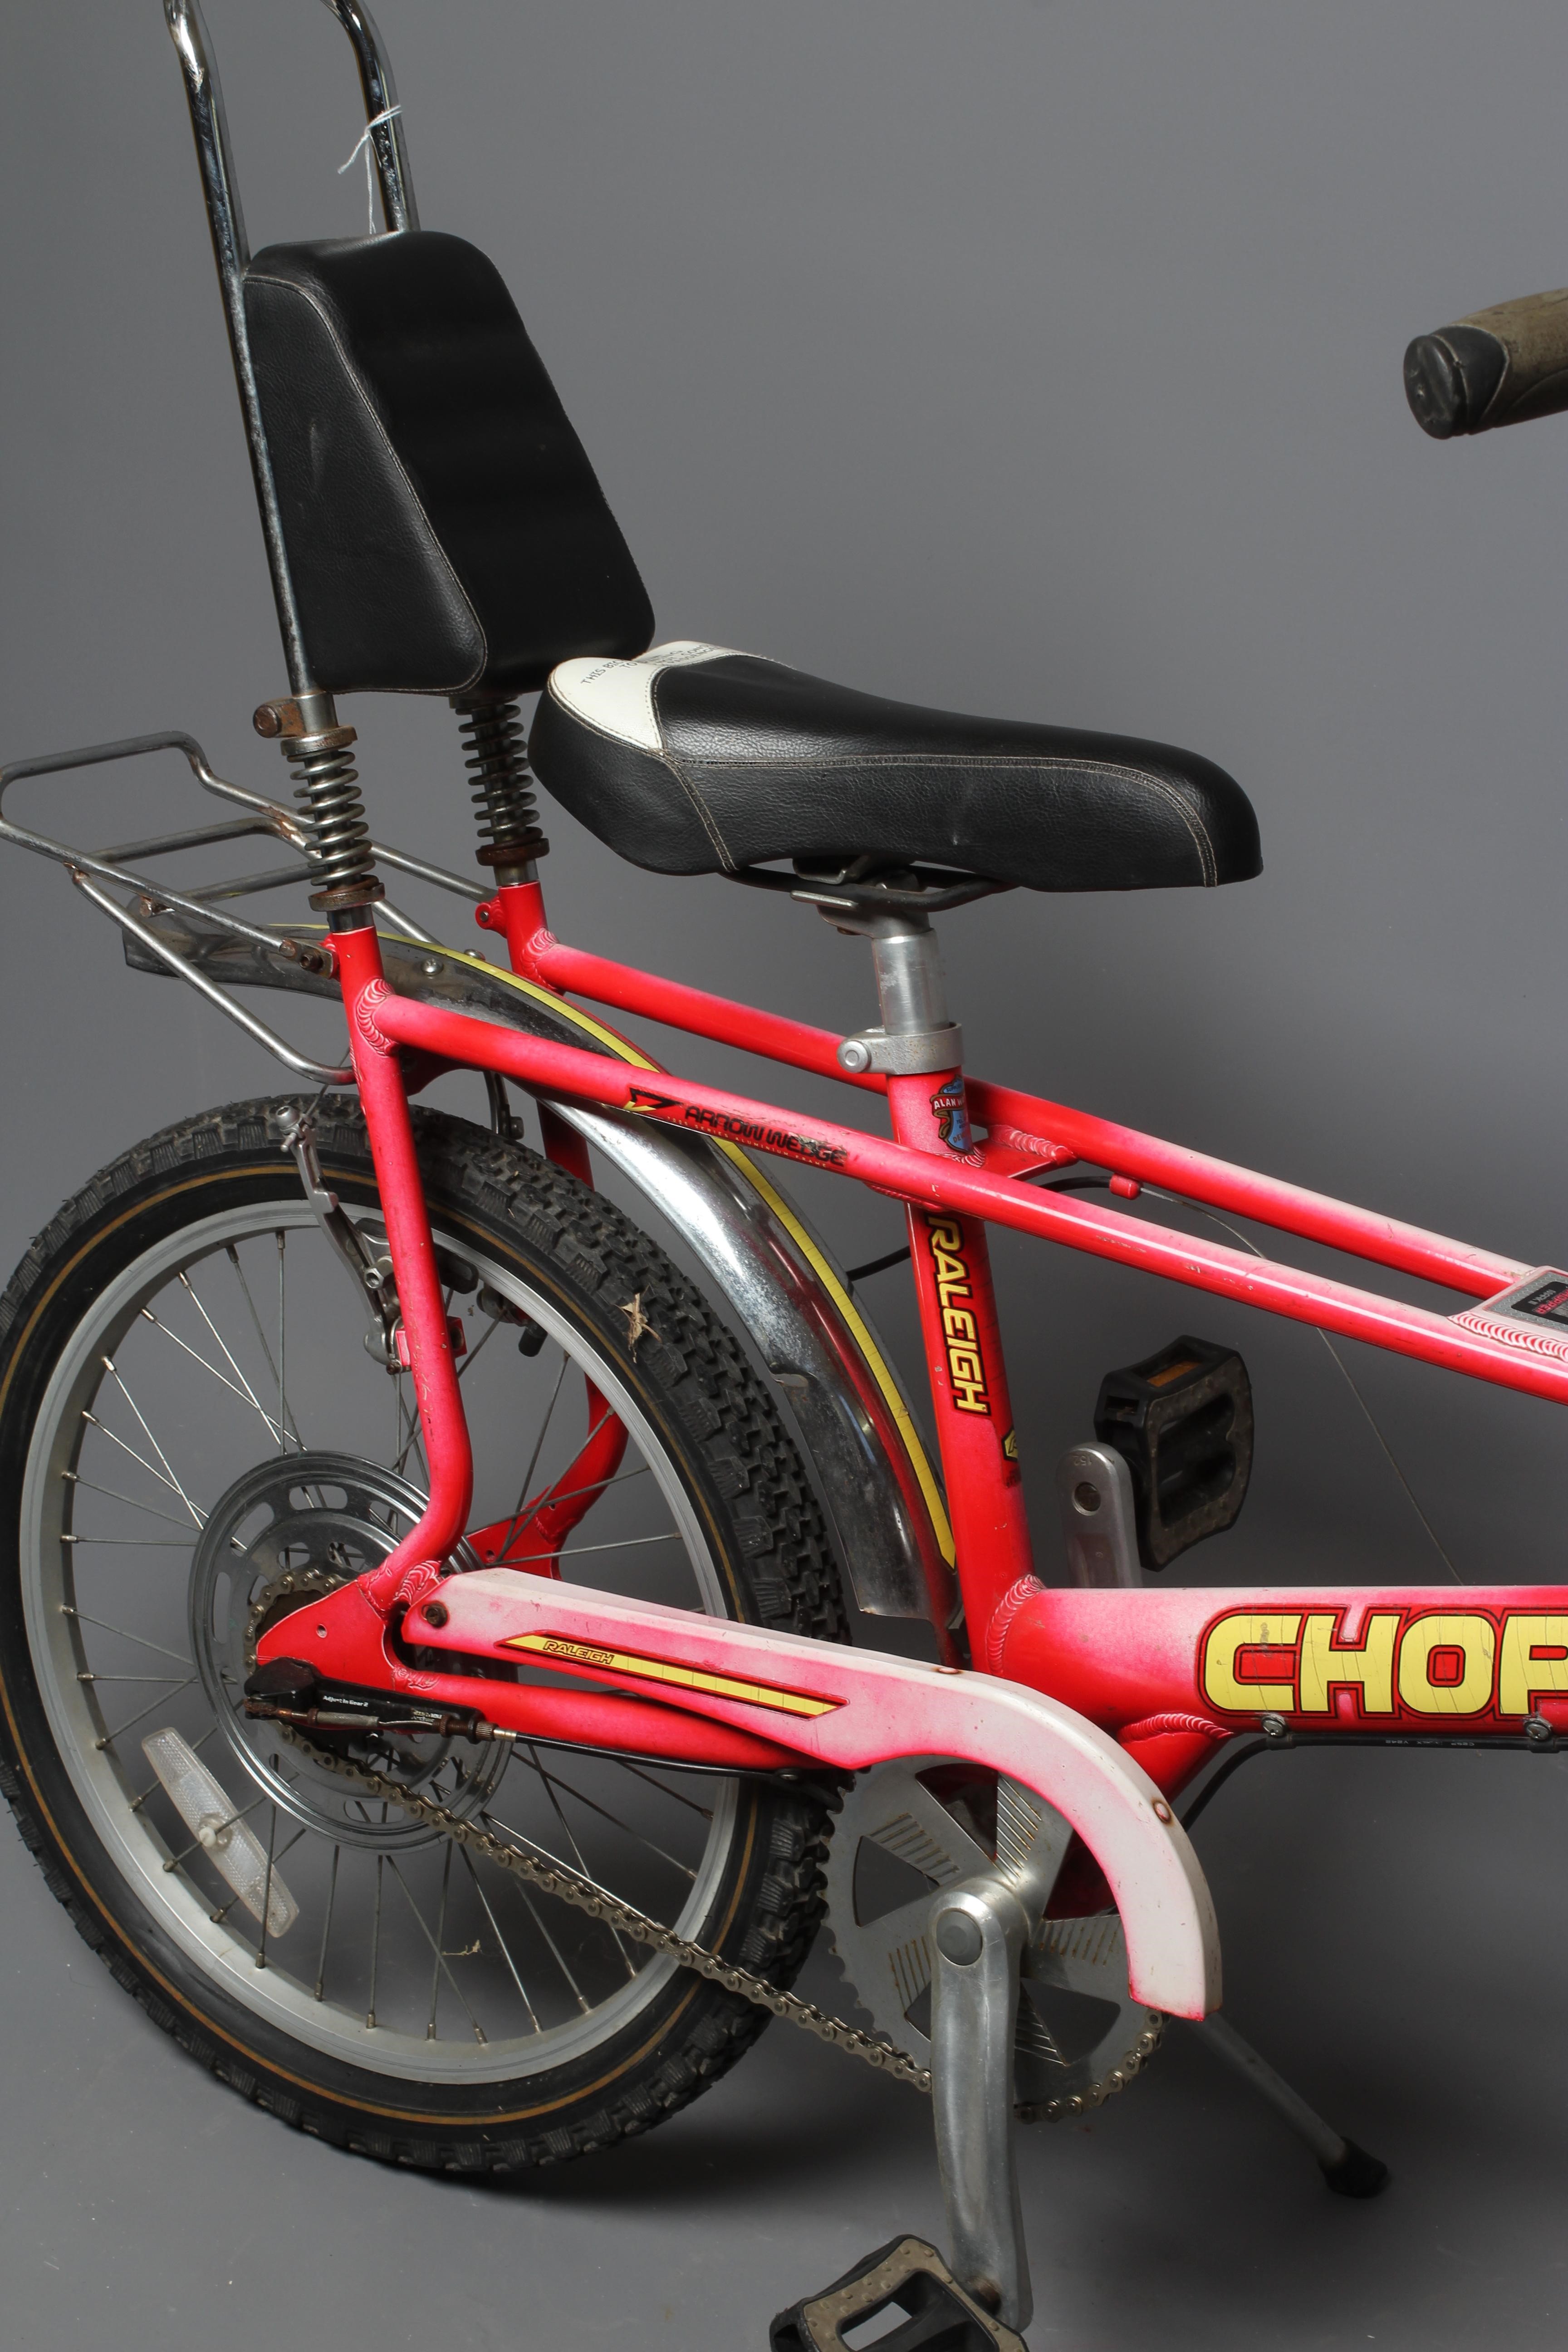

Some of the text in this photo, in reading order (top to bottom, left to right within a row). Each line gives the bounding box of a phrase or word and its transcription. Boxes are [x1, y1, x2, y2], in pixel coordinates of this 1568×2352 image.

[580, 668, 607, 684] THIS
[934, 1098, 956, 1110] ALAN
[695, 1124, 729, 1138] SERIES
[735, 1137, 789, 1156] ALUMINIUM
[795, 1155, 827, 1168] FRAME
[926, 1213, 990, 1415] RALEIGH
[543, 1640, 615, 1665] RALEIGH
[1203, 1612, 1568, 1716] CHOP
